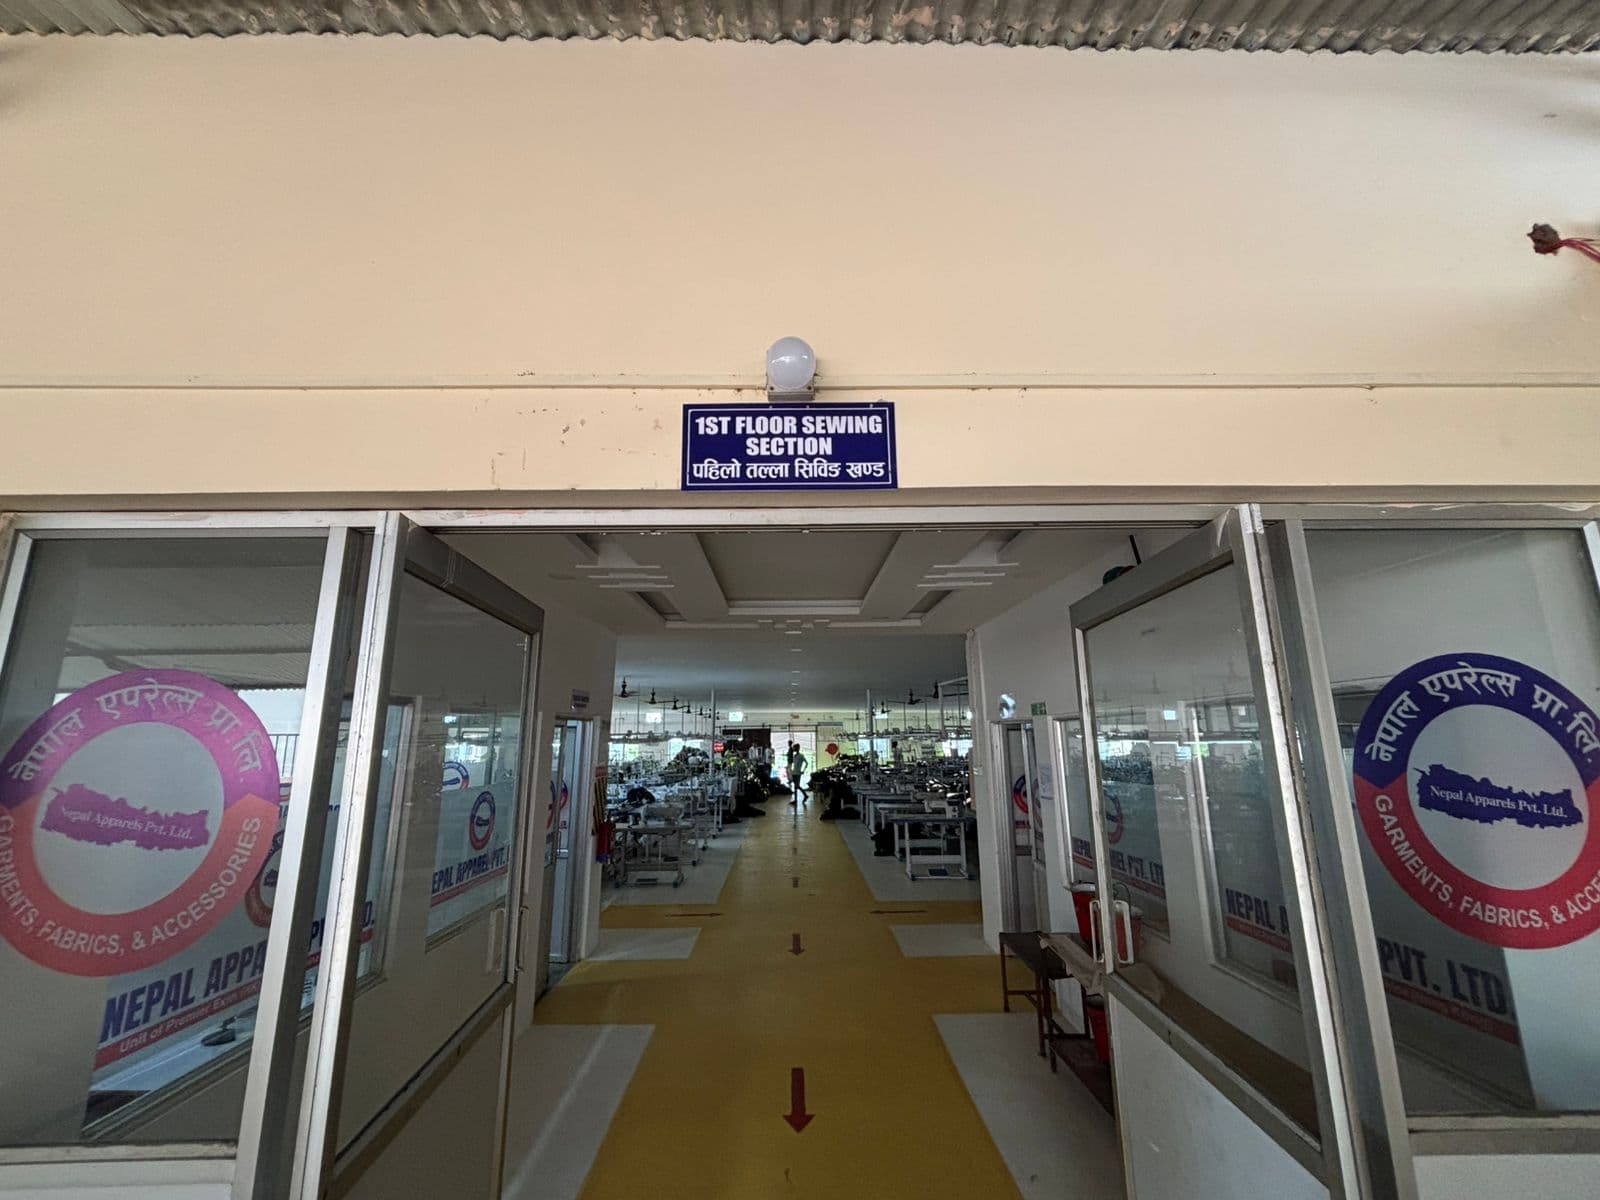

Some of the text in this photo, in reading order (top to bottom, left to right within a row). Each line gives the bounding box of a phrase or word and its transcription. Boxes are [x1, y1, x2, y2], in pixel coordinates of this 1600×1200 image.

[695, 415, 883, 435] 1ST FLOOR SEWING
[746, 437, 833, 456] SECTION
[693, 457, 886, 480] पहिलो तल्ला सिविङ खण्ड
[8, 708, 85, 782] नेपाल
[96, 678, 205, 720] एपरेल्स
[1364, 690, 1420, 762] नेपाल
[1418, 661, 1522, 703] एपरेल्स
[1430, 785, 1568, 819] Nepal Apparels Pvt. Ltd.
[36, 920, 125, 956] FABRICS,
[131, 931, 146, 950] &
[151, 817, 261, 946] ACCESSORIES
[1375, 794, 1453, 909] GARMENTS,
[1459, 895, 1550, 930] FABRICS,
[1551, 905, 1567, 925] &
[98, 967, 196, 1044] NEPAL
